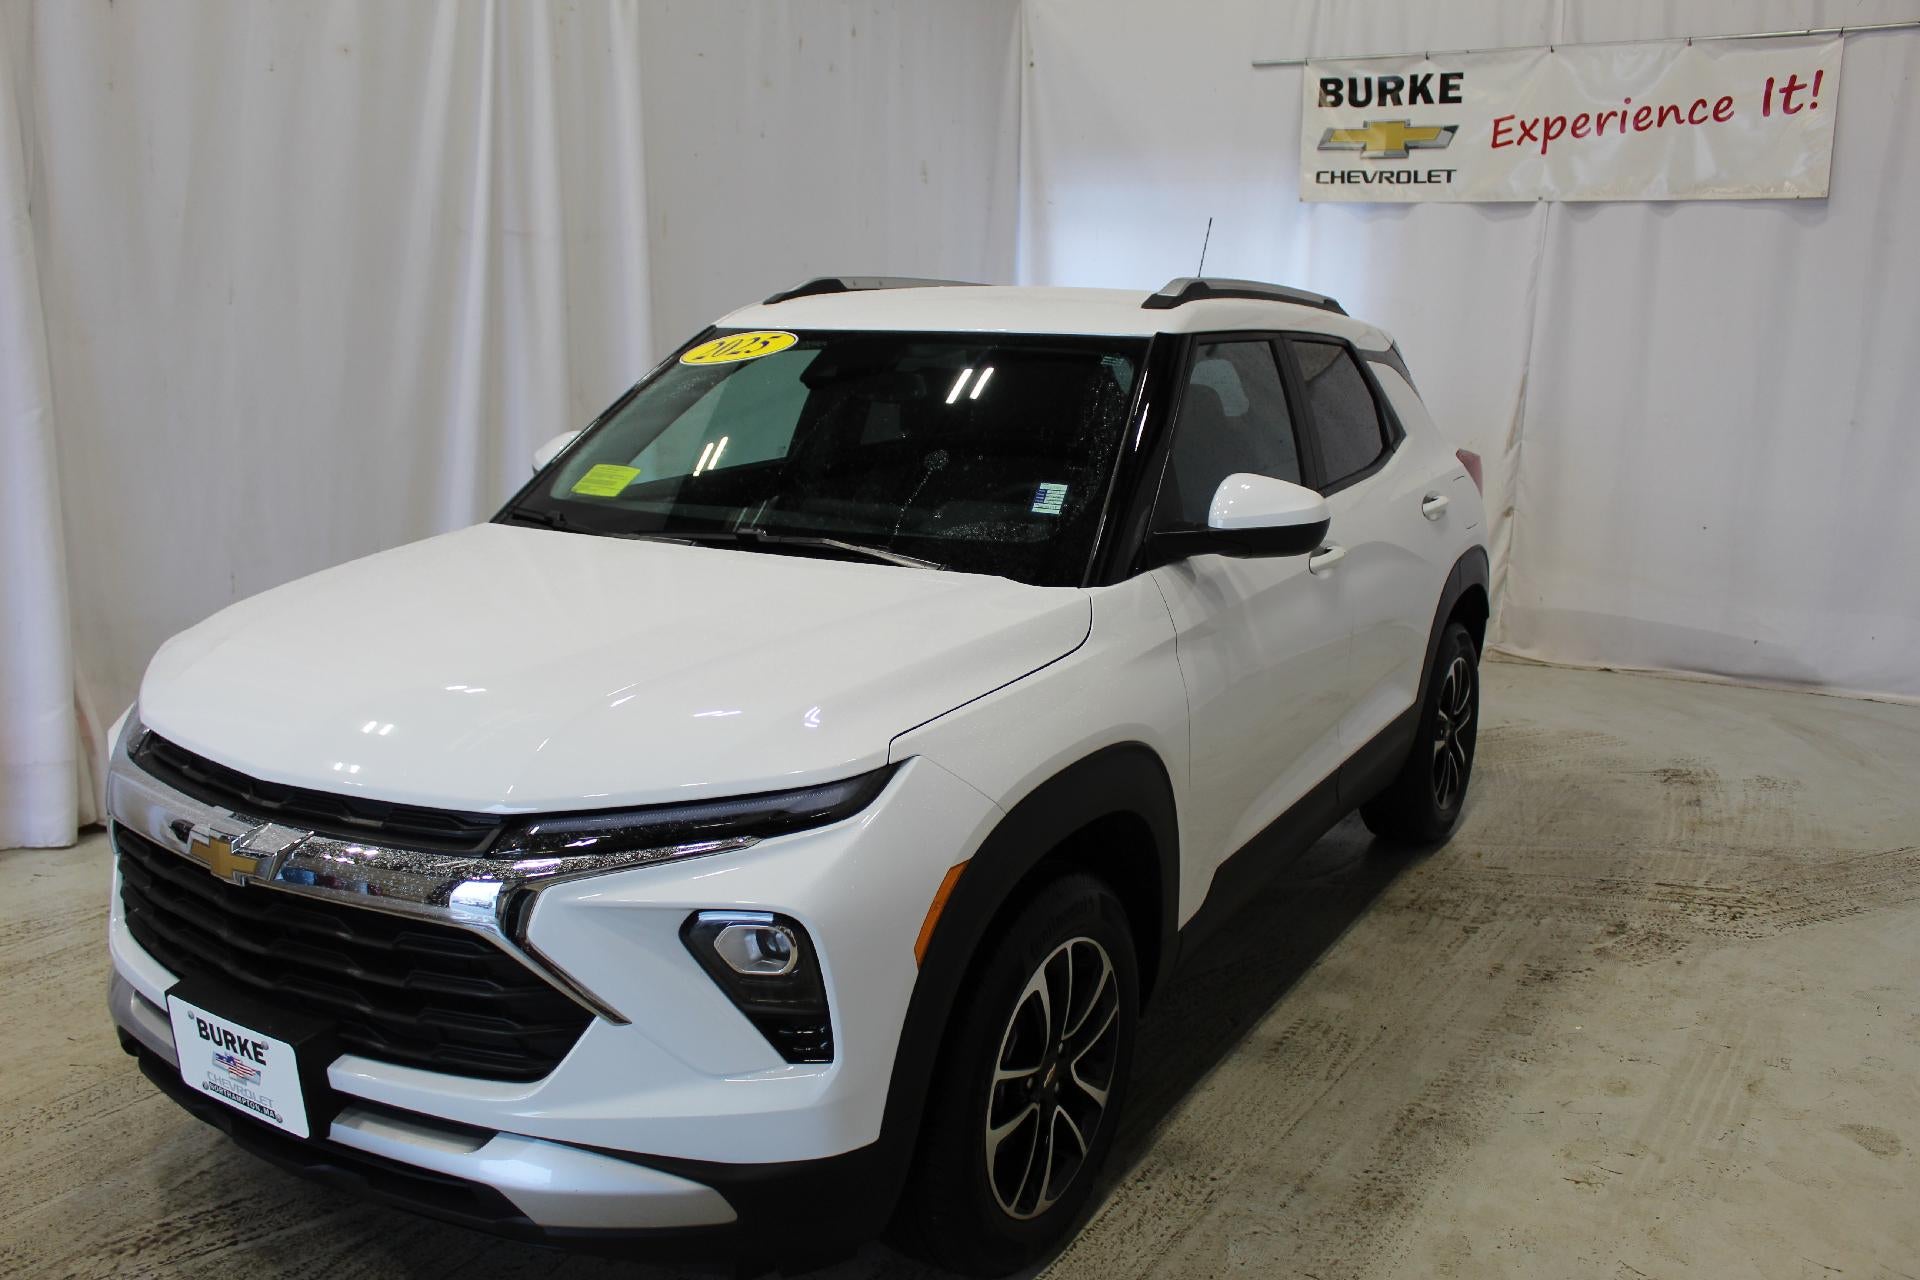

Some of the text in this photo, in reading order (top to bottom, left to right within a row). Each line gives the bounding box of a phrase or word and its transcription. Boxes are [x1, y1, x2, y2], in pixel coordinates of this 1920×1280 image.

[1318, 72, 1464, 108] BURKE
[1491, 69, 1824, 155] Experience It!
[1316, 169, 1457, 184] CHEVROLET
[692, 336, 782, 360] 2025
[196, 1016, 267, 1066] BURKE
[207, 1071, 274, 1108] CHEVROLET
